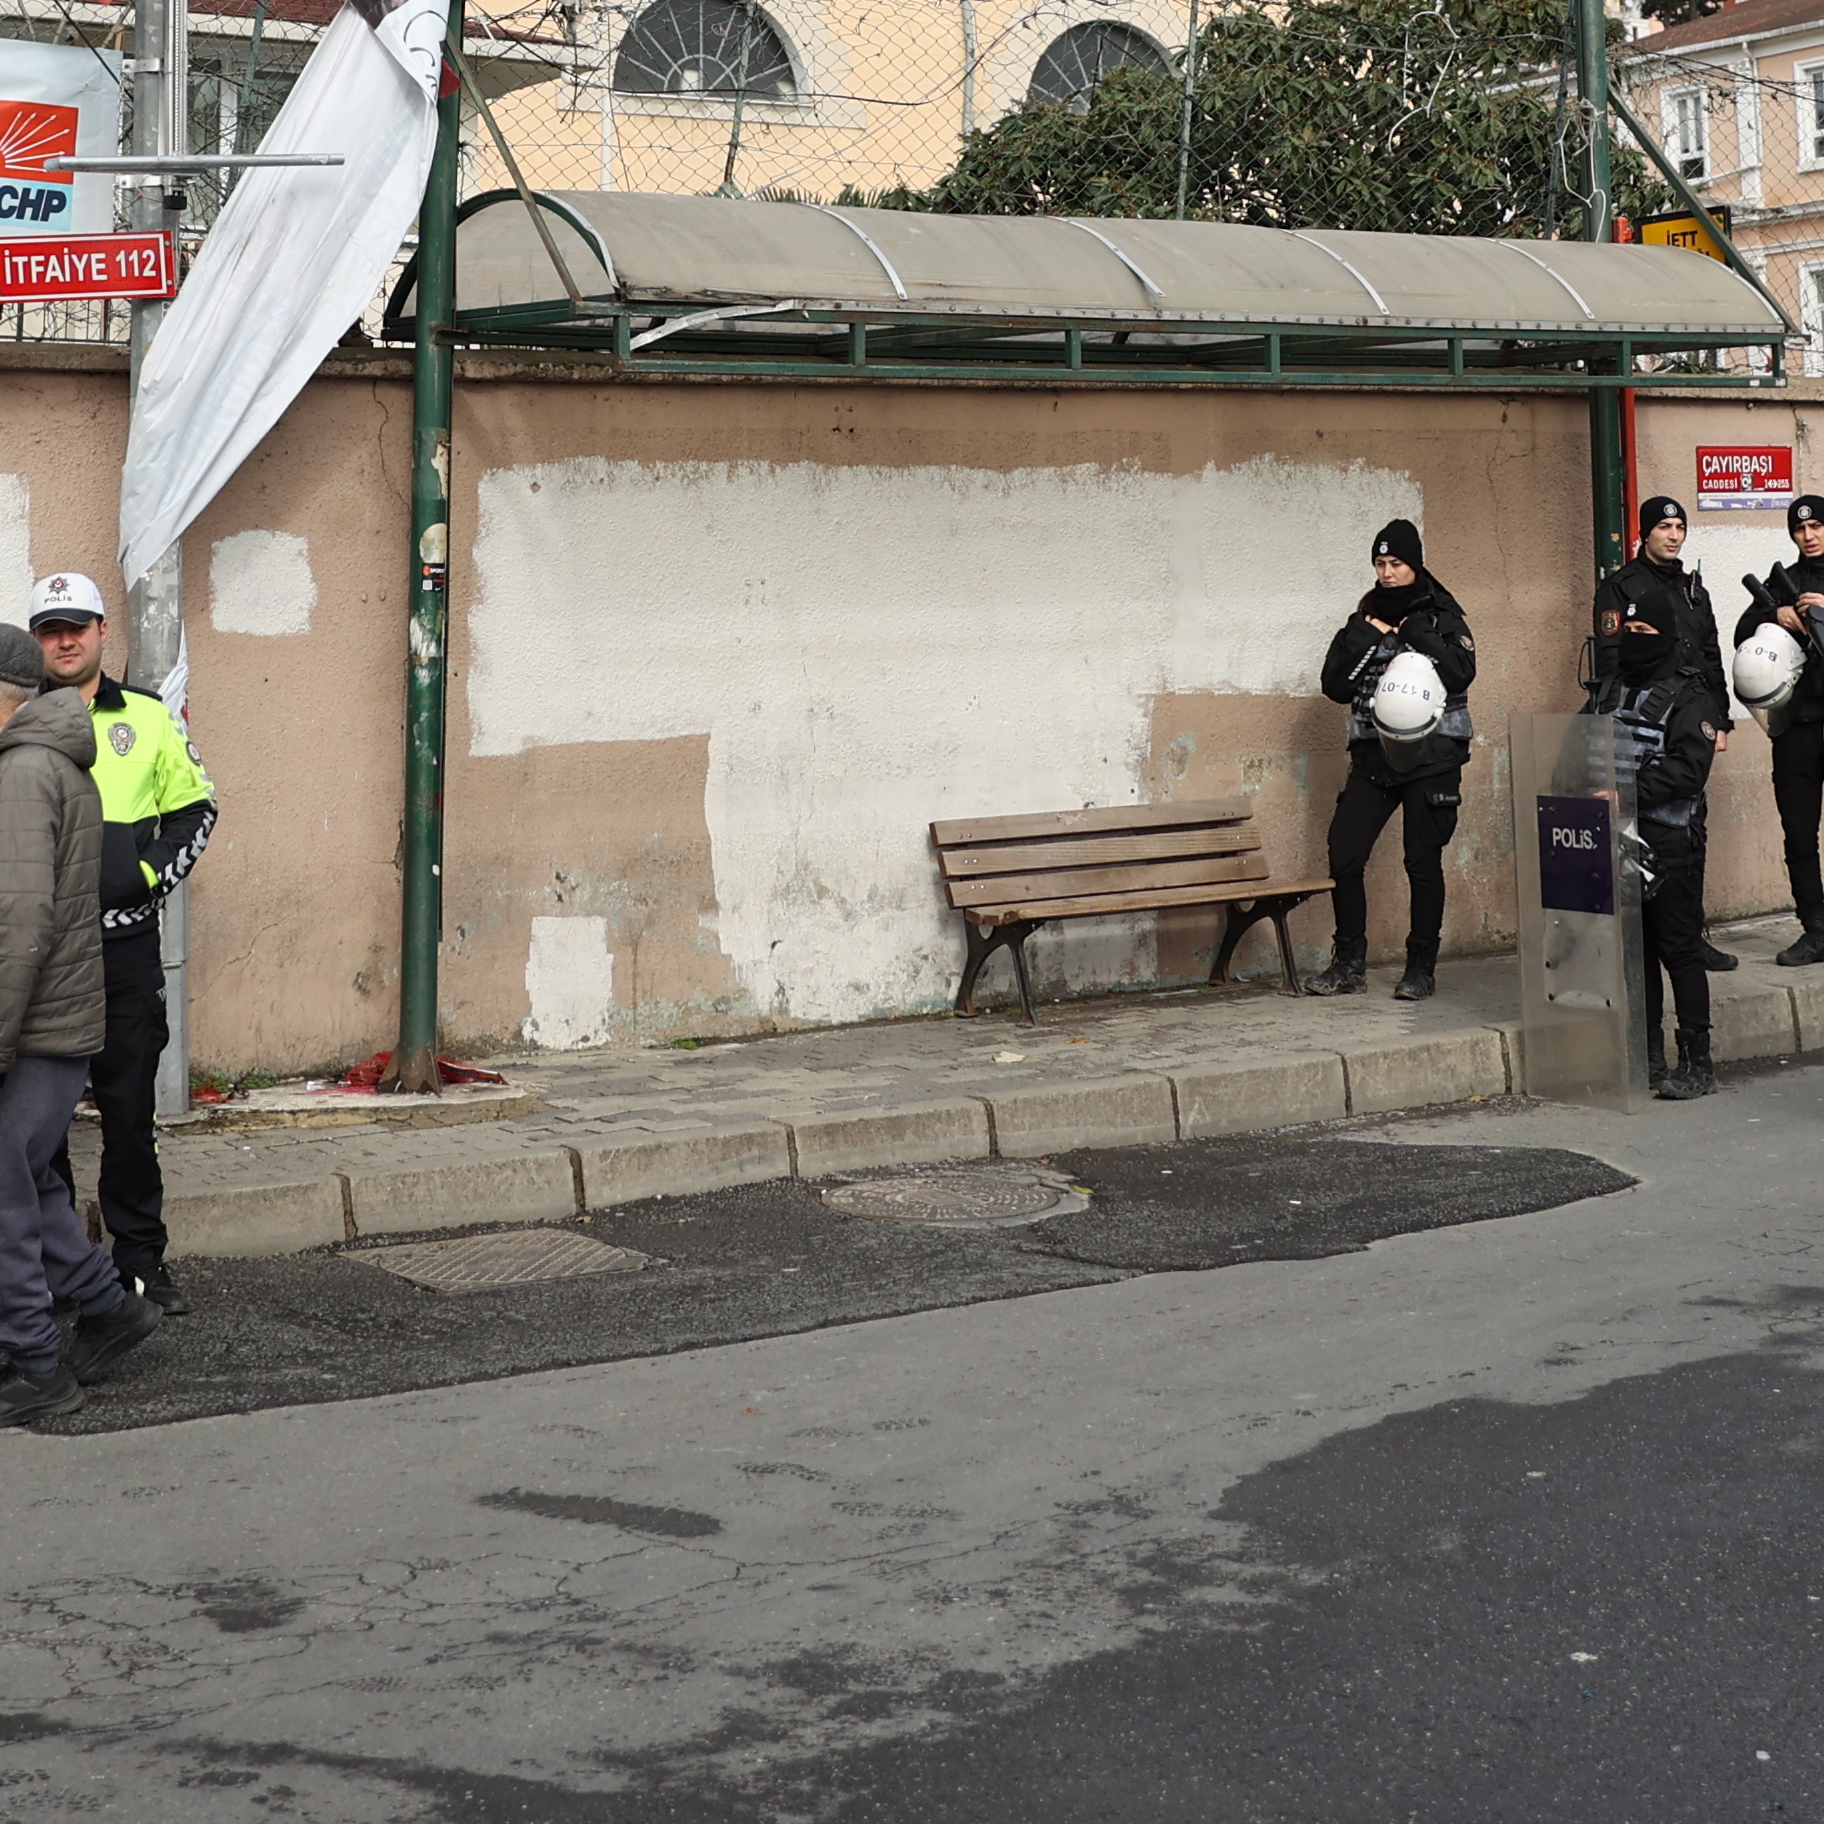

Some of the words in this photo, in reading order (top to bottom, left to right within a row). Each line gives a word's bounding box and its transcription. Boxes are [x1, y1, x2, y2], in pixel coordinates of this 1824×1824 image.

[1666, 229, 1698, 248] İETT
[4, 247, 108, 285] İTFAİYE
[115, 249, 157, 278] 112
[1702, 455, 1772, 476] ÇAYIRBAŞI
[1702, 477, 1738, 489] CADDESİ
